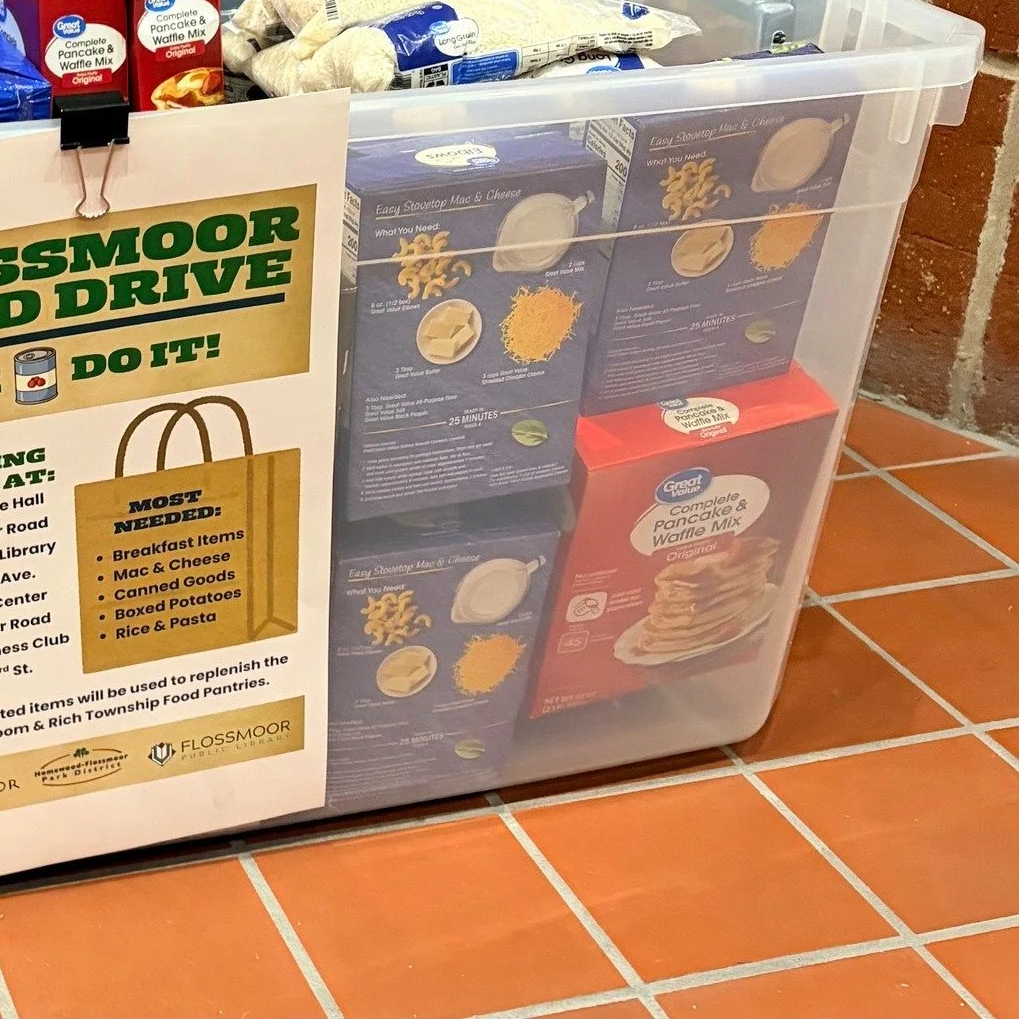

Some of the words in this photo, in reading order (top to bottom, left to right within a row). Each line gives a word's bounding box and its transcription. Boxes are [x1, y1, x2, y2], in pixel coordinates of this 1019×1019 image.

[57, 20, 80, 30] Great
[150, 18, 197, 34] Pancake
[199, 16, 206, 25] &
[156, 10, 198, 22] Complete
[65, 38, 106, 48] Complete
[152, 32, 185, 45] Waffle
[188, 29, 206, 39] Mix
[58, 46, 105, 60] Pancake
[107, 44, 114, 54] &
[165, 46, 196, 58] Original
[59, 59, 92, 71] Waffle
[95, 56, 114, 66] Mix
[72, 74, 102, 85] Original
[646, 157, 668, 167] What
[668, 156, 682, 164] You
[376, 204, 400, 216] Easy
[403, 197, 448, 214] Stovetop
[450, 193, 471, 205] Mac
[474, 191, 482, 202] &
[486, 188, 522, 201] Cheese
[374, 226, 398, 238] What
[398, 225, 414, 236] You
[55, 249, 292, 320] DRIVE
[690, 322, 700, 330] 25
[701, 314, 736, 328] MINUTES
[72, 346, 142, 380] DO
[150, 333, 222, 368] IT!
[674, 408, 718, 422] Pancake
[677, 403, 714, 414] Complete
[448, 416, 460, 426] 25
[461, 410, 498, 424] MINUTES
[681, 417, 712, 429] Waffle
[712, 413, 730, 422] Mix
[3, 470, 56, 490] AT:
[663, 474, 703, 493] Great
[12, 492, 45, 509] Hall
[671, 485, 701, 498] Value
[128, 489, 202, 514] MOST
[669, 492, 740, 516] Complete
[114, 506, 222, 534] NEEDED:
[654, 504, 733, 533] Pancake
[736, 498, 748, 512] &
[6, 516, 48, 534] Road
[652, 524, 706, 548] Waffle
[710, 516, 742, 533] Mix
[0, 541, 57, 560] Library
[112, 537, 194, 562] Breakfast
[198, 530, 244, 547] Items
[666, 542, 718, 562] Original
[113, 564, 149, 582] Mac
[152, 562, 165, 574] &
[168, 552, 231, 571] Cheese
[348, 568, 372, 579] Easy
[416, 560, 435, 570] Mac
[0, 570, 36, 585] Ave.
[114, 578, 180, 601] Canned
[183, 570, 236, 588] Goods
[346, 587, 367, 596] What
[368, 586, 382, 594] You
[115, 600, 166, 620] Boxed
[169, 588, 242, 610] Potatoes
[10, 612, 52, 630] Road
[116, 622, 150, 640] Rice
[153, 620, 166, 632] &
[170, 611, 217, 629] Pasta
[32, 632, 70, 650] Club
[13, 663, 34, 676] St.
[30, 696, 74, 713] items
[77, 688, 104, 705] will
[107, 684, 127, 700] be
[130, 678, 168, 694] used
[170, 674, 186, 686] to
[189, 660, 262, 684] replenish
[264, 654, 289, 668] the
[33, 720, 46, 732] &
[48, 712, 82, 729] Rich
[85, 696, 160, 721] Township
[162, 690, 200, 706] Food
[203, 677, 270, 698] Pantries.
[180, 720, 292, 752] FLOSSMOOR
[180, 746, 230, 760] PUBLIC
[236, 733, 292, 750] LIBRARY
[34, 752, 129, 778] Homewood-Flossmoor
[41, 772, 69, 783] Park
[74, 762, 122, 776] District
